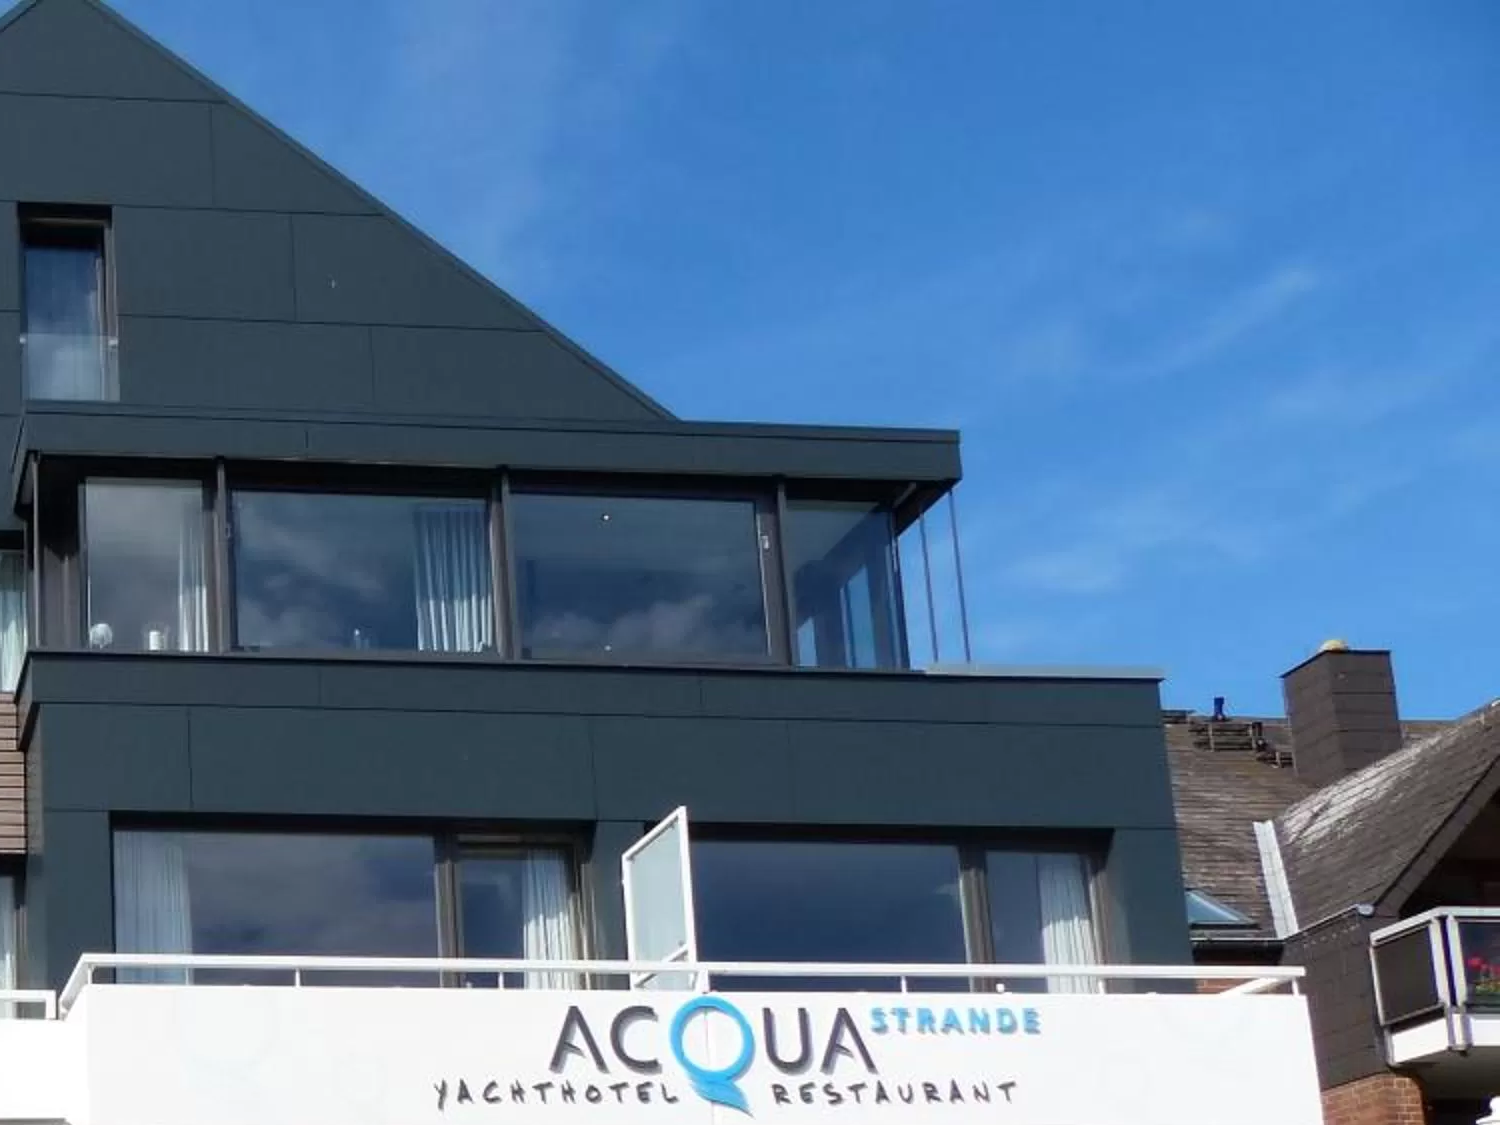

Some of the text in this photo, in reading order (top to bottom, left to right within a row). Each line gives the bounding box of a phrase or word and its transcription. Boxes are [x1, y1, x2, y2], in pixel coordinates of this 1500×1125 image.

[549, 995, 1041, 1116] ACQUA STRANDE
[434, 1079, 1017, 1111] YACHTHOTEL RESTAURANT
